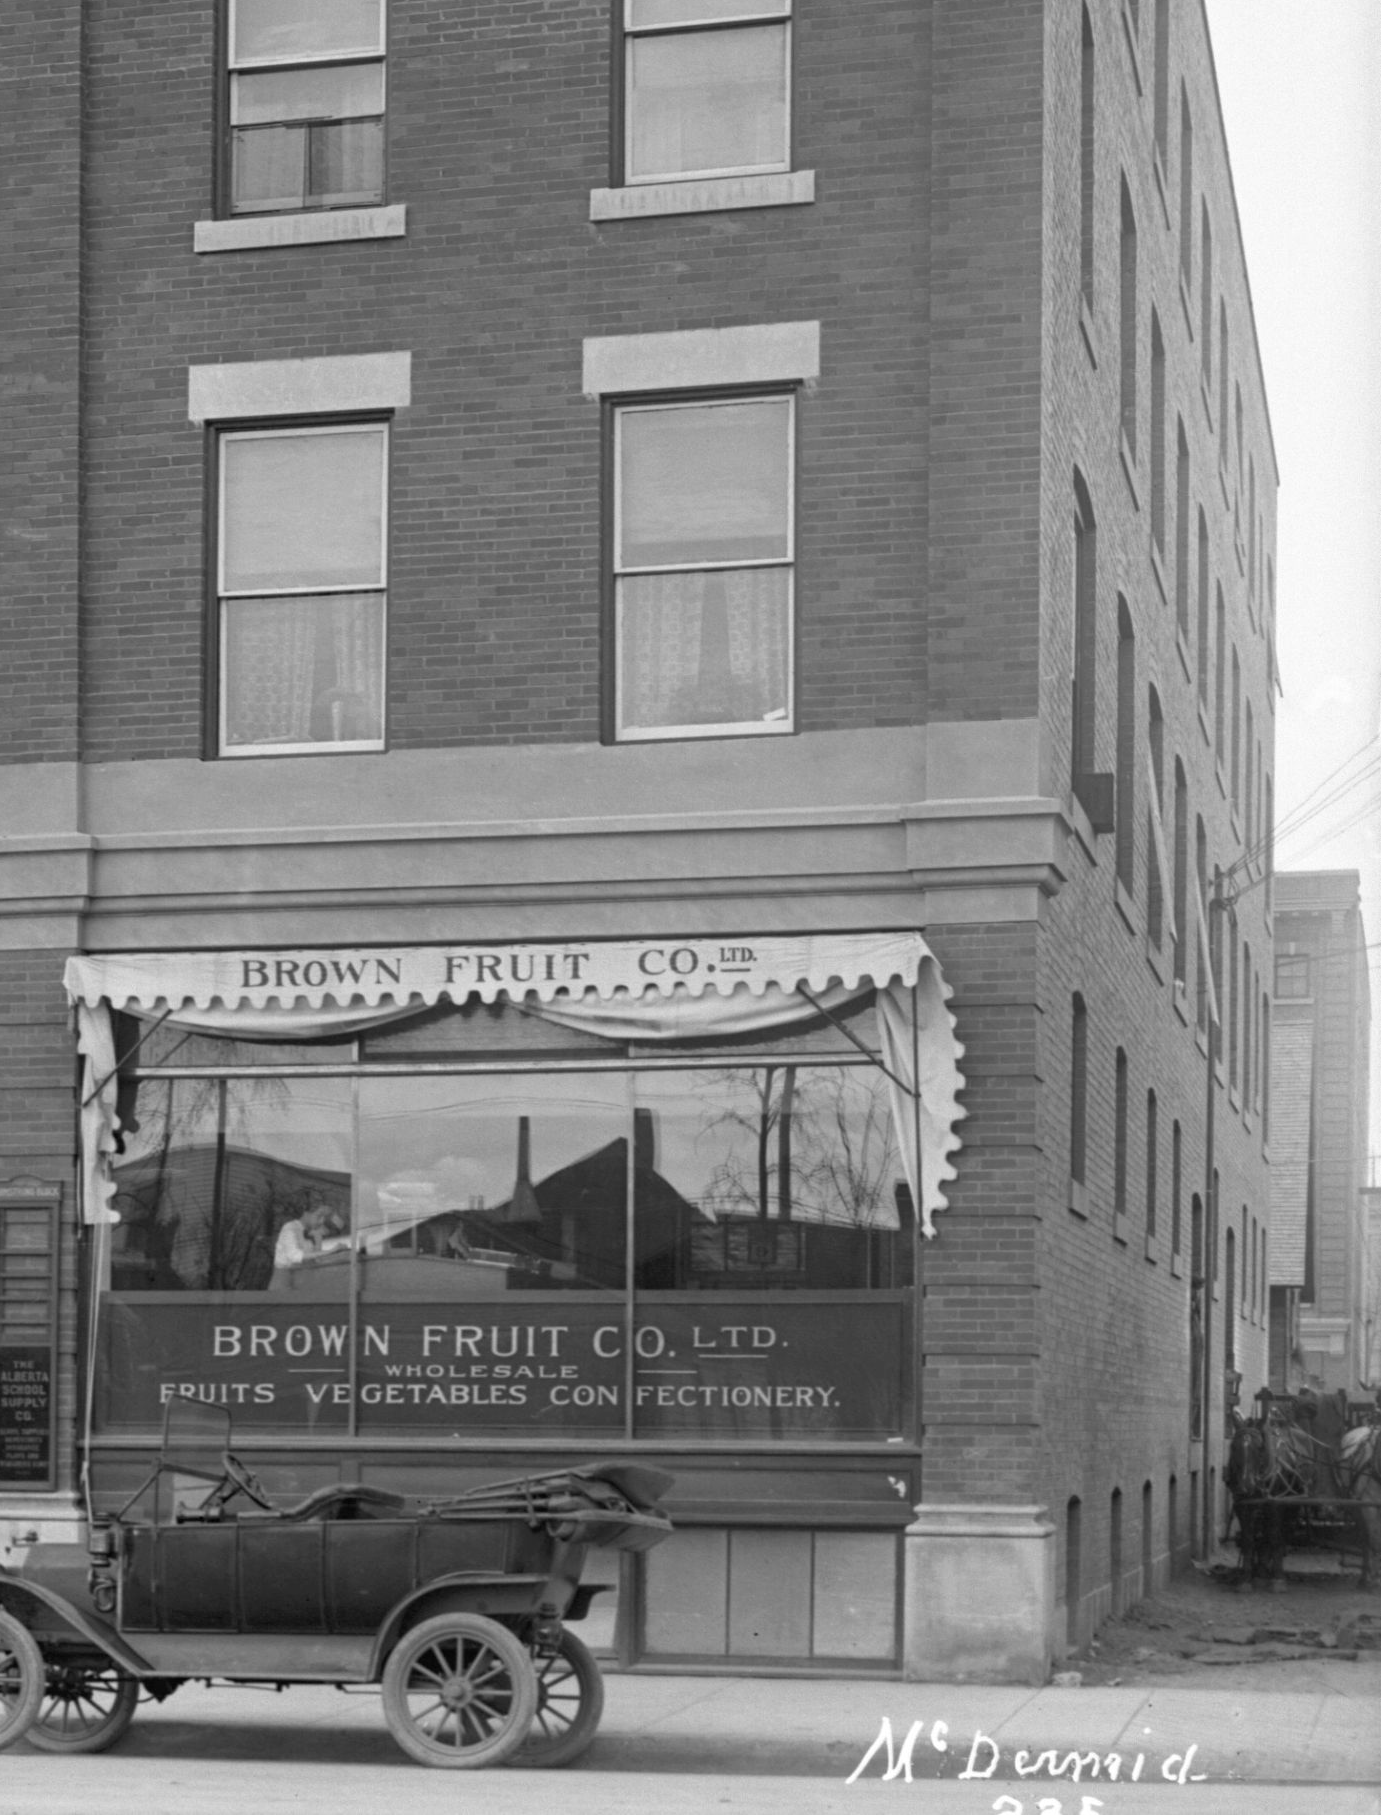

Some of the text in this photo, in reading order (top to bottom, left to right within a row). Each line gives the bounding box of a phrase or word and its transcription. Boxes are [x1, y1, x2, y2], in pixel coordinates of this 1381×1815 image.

[241, 946, 758, 988] BROWN FRUIT CO. LTD.
[212, 1325, 789, 1358] BROWN FRUIT CO. LTD.
[13, 1360, 35, 1369] THE
[1, 1371, 49, 1382] ALBERTA
[384, 1364, 579, 1379] WHOLESALE
[2, 1384, 46, 1395] SCHOOL
[159, 1383, 841, 1407] FRUITS VEGETABLES CONFECTIONERY.
[0, 1397, 47, 1407] SUPPLY
